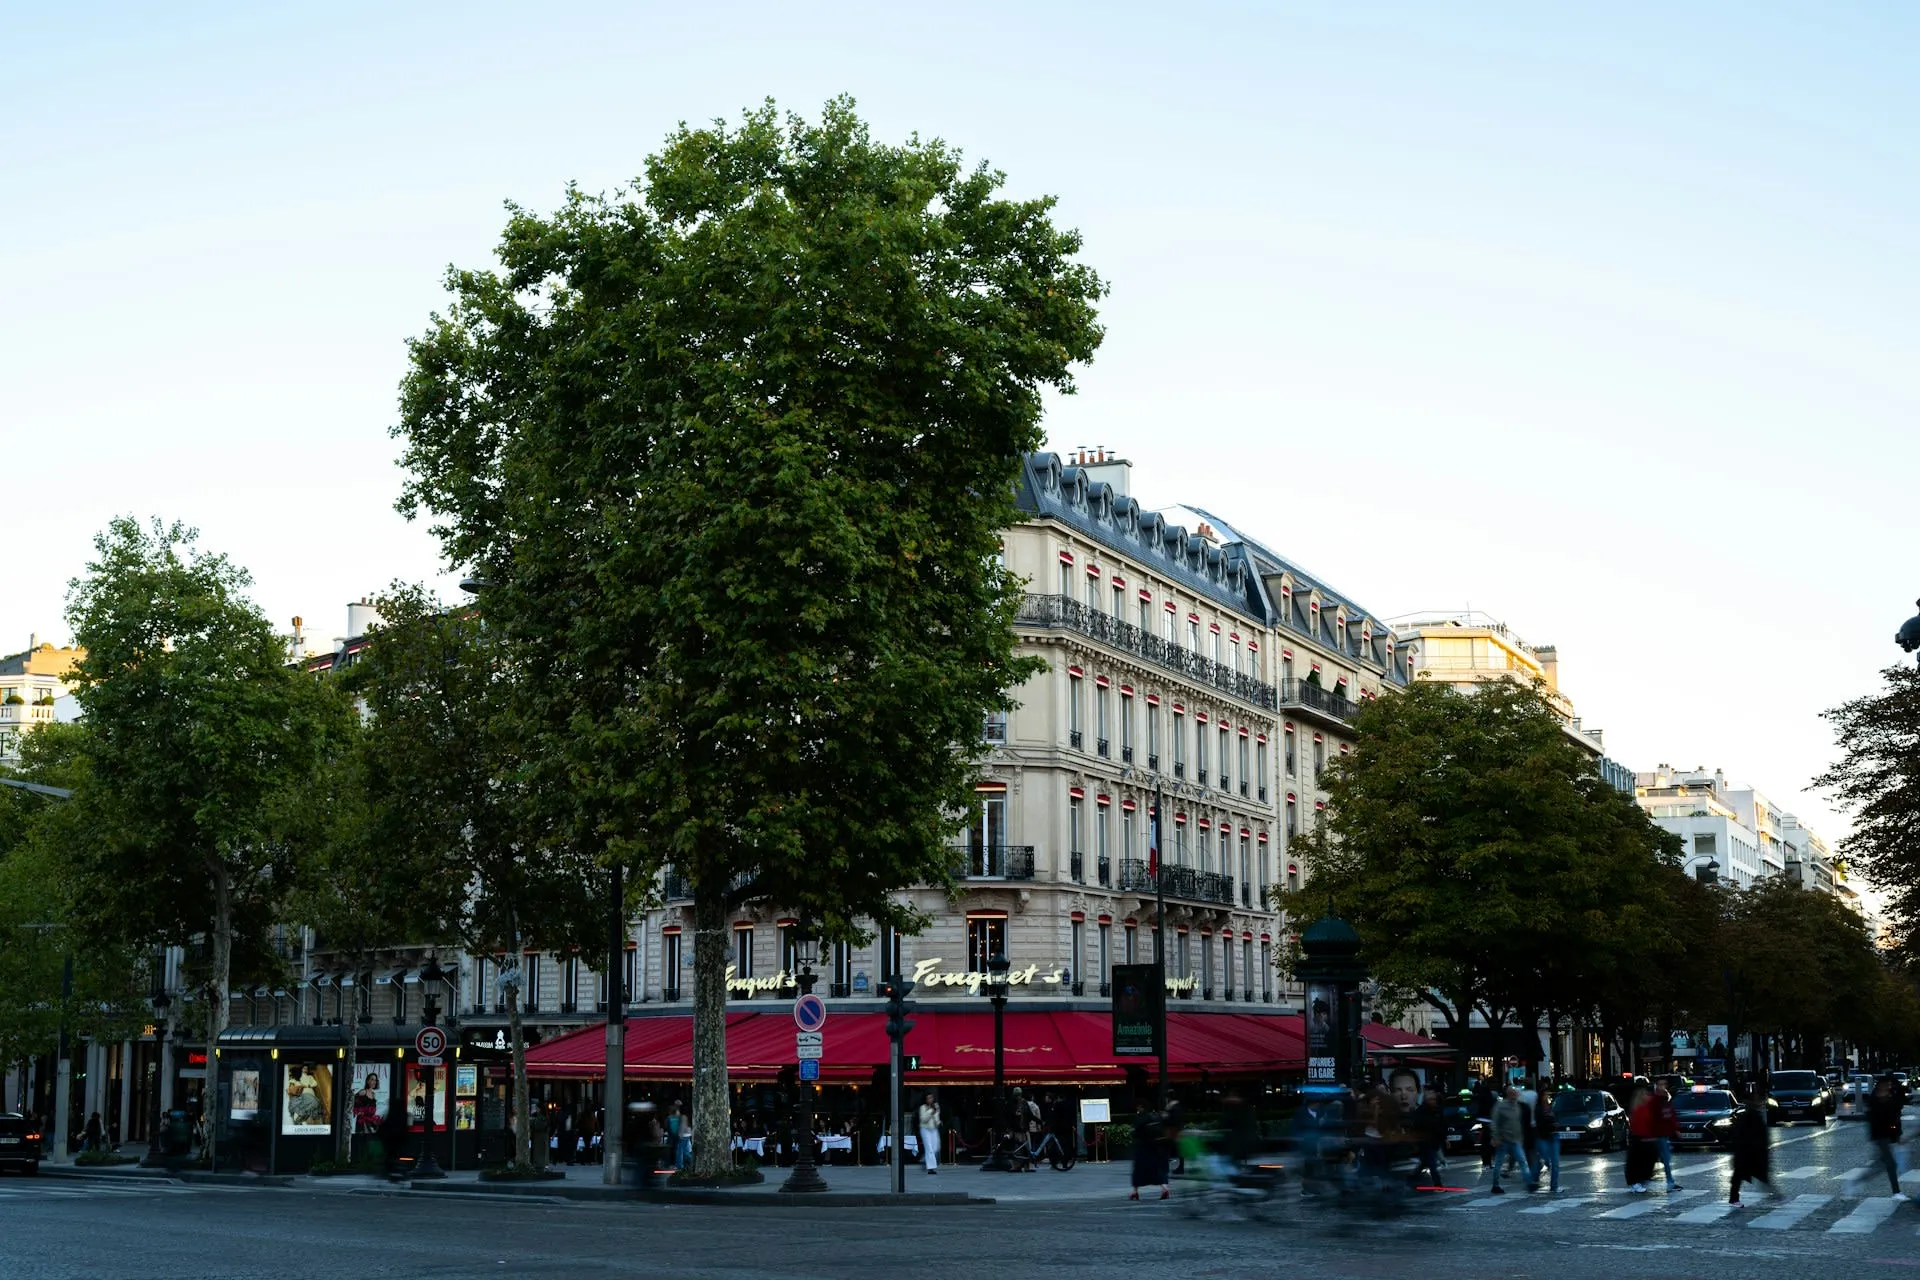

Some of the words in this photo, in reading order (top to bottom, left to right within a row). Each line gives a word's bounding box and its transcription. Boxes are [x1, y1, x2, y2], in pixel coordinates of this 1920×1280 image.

[1165, 971, 1200, 998] uquet's
[423, 1036, 440, 1049] 50
[355, 1064, 388, 1080] RAZIA
